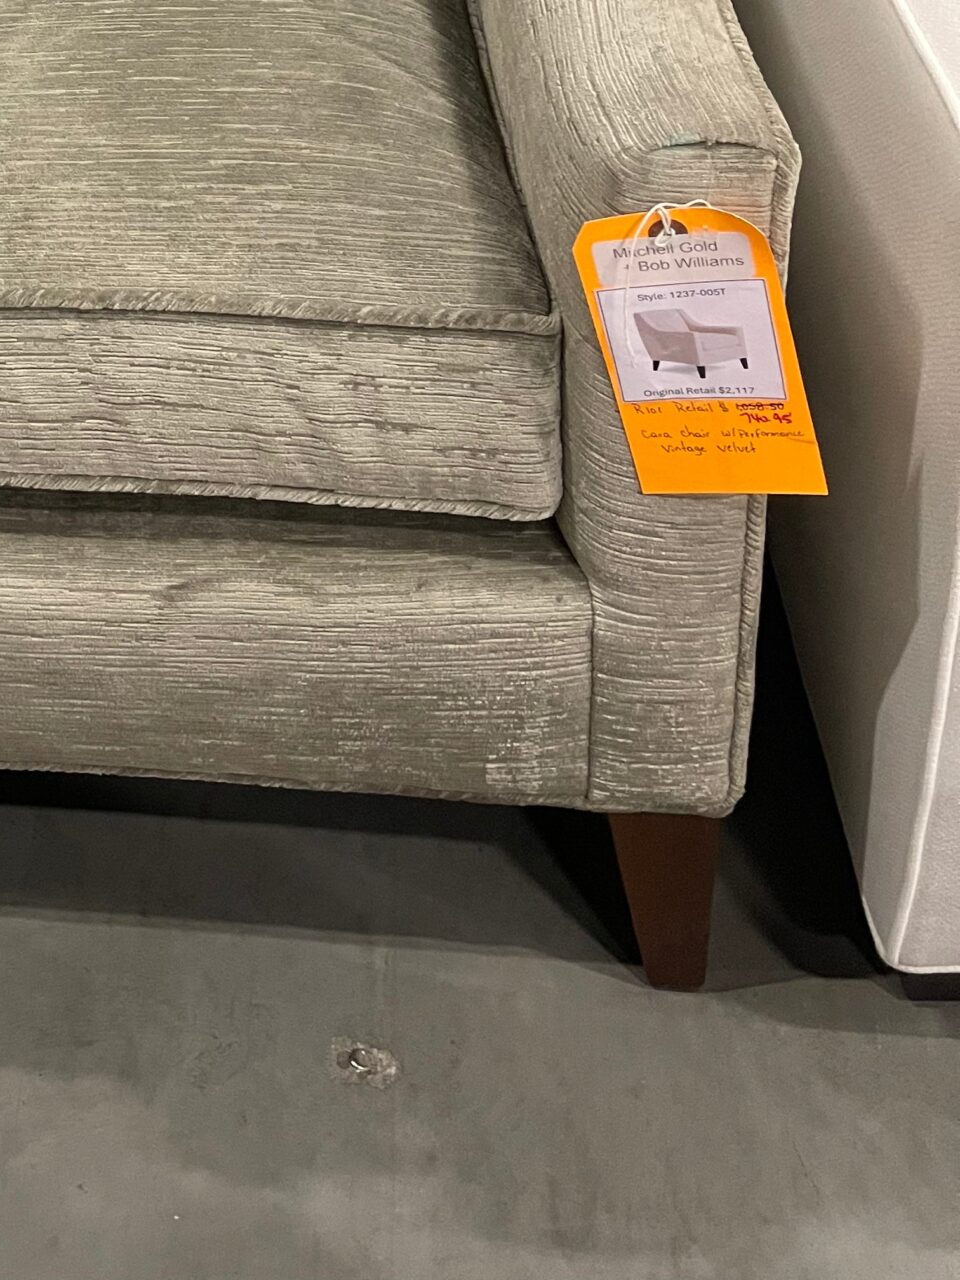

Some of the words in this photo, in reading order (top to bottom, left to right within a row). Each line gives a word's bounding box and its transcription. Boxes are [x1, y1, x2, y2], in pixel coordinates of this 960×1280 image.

[679, 240, 718, 254] Gold
[638, 260, 670, 272] Bob
[675, 256, 744, 270] Williams
[637, 293, 666, 303] Style:
[669, 288, 727, 299] 1237-005T
[643, 388, 684, 398] Original
[686, 386, 715, 395] Retail
[672, 400, 714, 413] Retail
